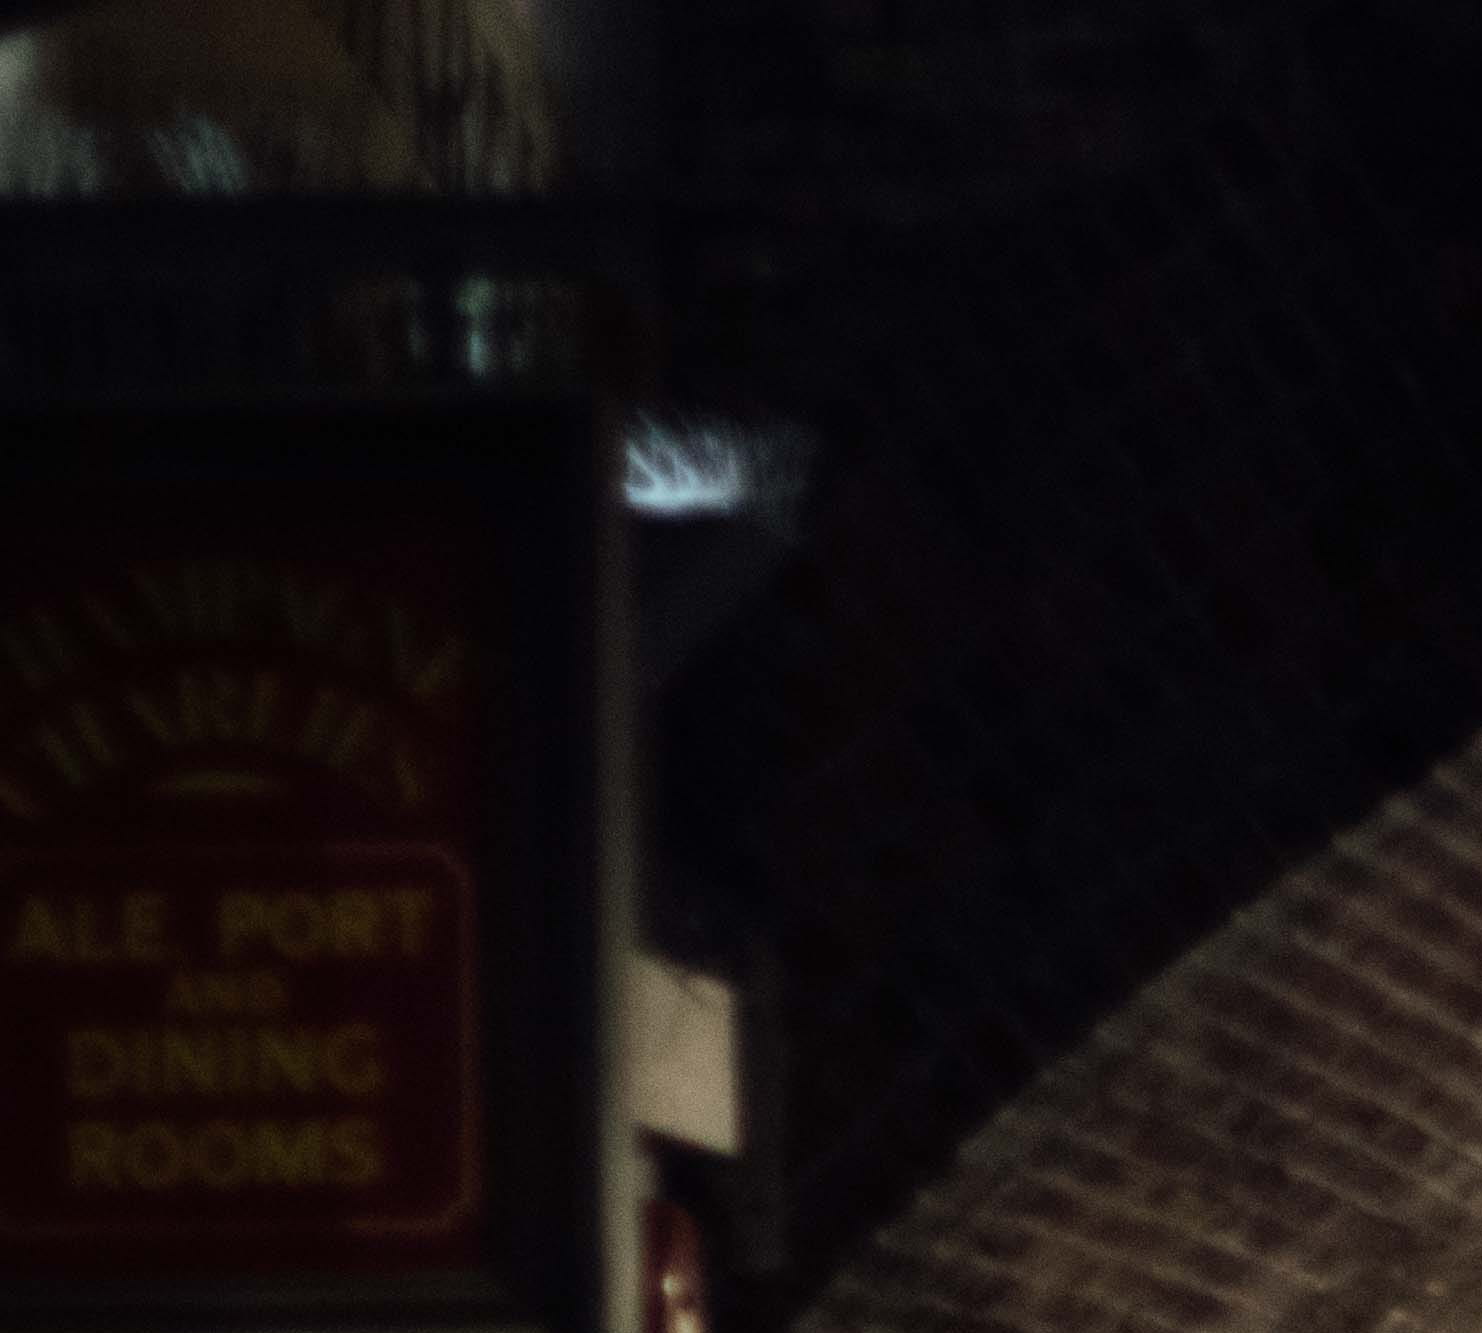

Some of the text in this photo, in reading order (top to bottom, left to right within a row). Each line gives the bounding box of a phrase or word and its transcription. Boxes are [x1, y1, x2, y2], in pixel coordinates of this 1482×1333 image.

[214, 886, 436, 959] PORT
[165, 969, 289, 1016] AND
[66, 1025, 385, 1100] DINING
[68, 1119, 384, 1192] ROOMS
